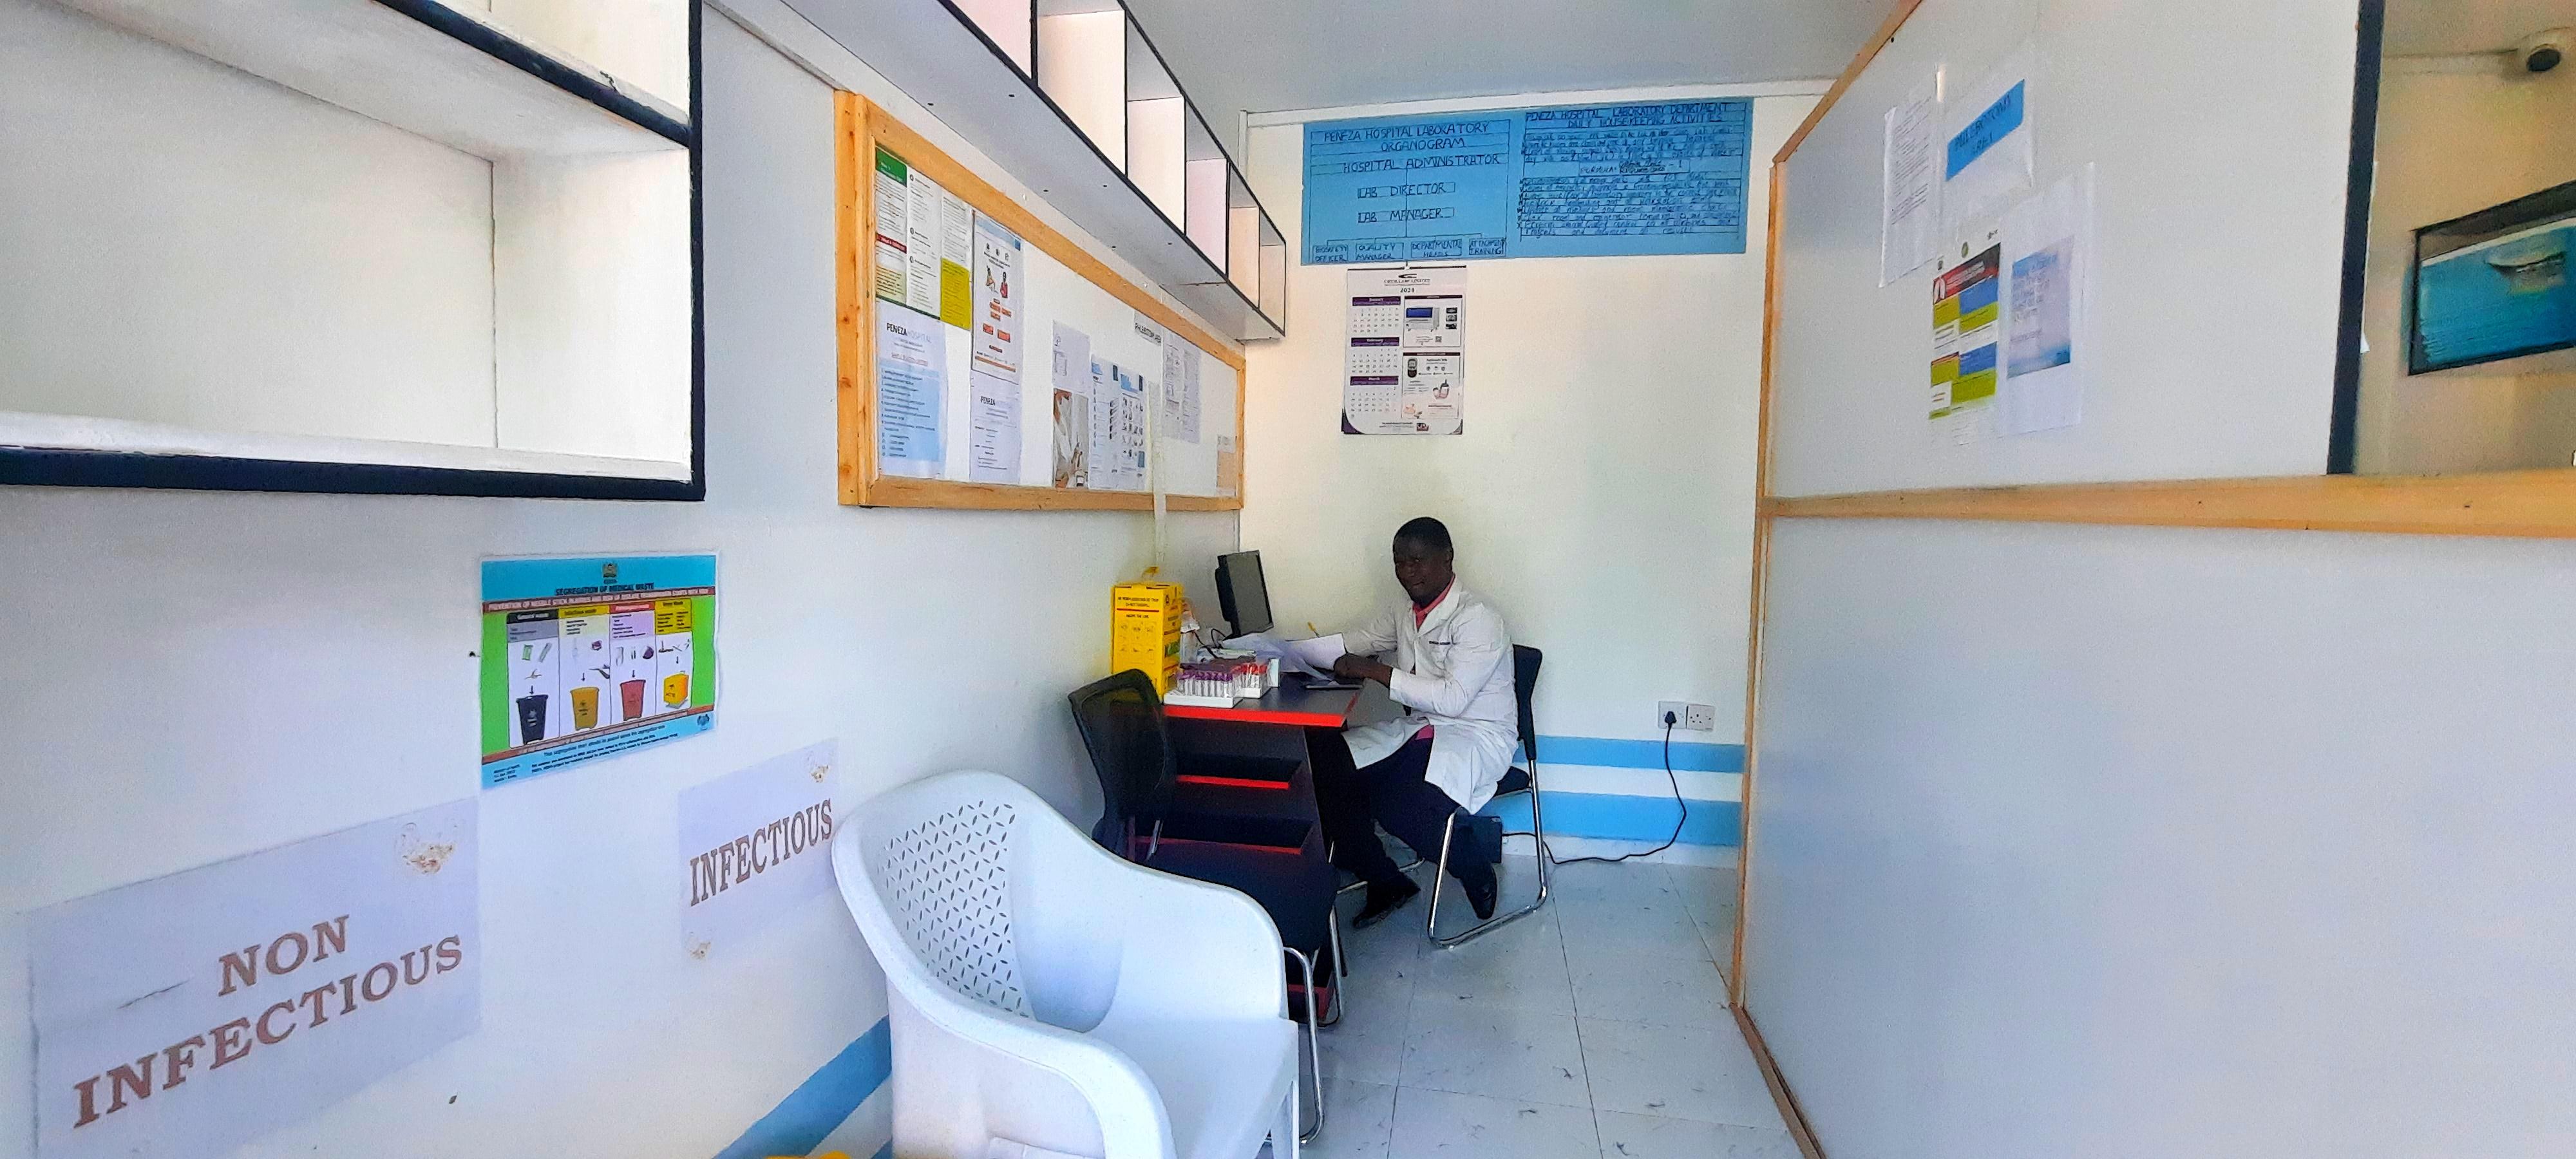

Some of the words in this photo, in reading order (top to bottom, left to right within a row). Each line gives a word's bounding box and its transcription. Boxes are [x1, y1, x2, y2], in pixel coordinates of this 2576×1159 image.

[1561, 108, 1603, 119] HOSPITAL
[1613, 105, 1665, 117] LABORATORY
[1671, 102, 1728, 114] DEPARTMENT
[1671, 113, 1722, 124] ACTIVITIES
[1324, 131, 1361, 142] PENEZA
[1366, 126, 1413, 139] HOSPITAL
[1417, 120, 1489, 136] LABORATORY
[1381, 138, 1466, 152] ORGANOGRAM
[1343, 159, 1396, 173] HOSPITAL
[1406, 154, 1500, 169] ADMINISTRATOR
[1358, 186, 1378, 198] LAB
[1390, 182, 1446, 196] DIRECTOR
[1358, 212, 1378, 223] LAB
[1390, 207, 1444, 221] MANAGER
[886, 323, 907, 336] PENEZA
[555, 587, 598, 596] SEGREGATION
[636, 582, 654, 590] WASTE
[690, 798, 832, 907] INFECTIOUS
[218, 914, 350, 996] NON
[73, 935, 462, 1129] INFECTIOUS
